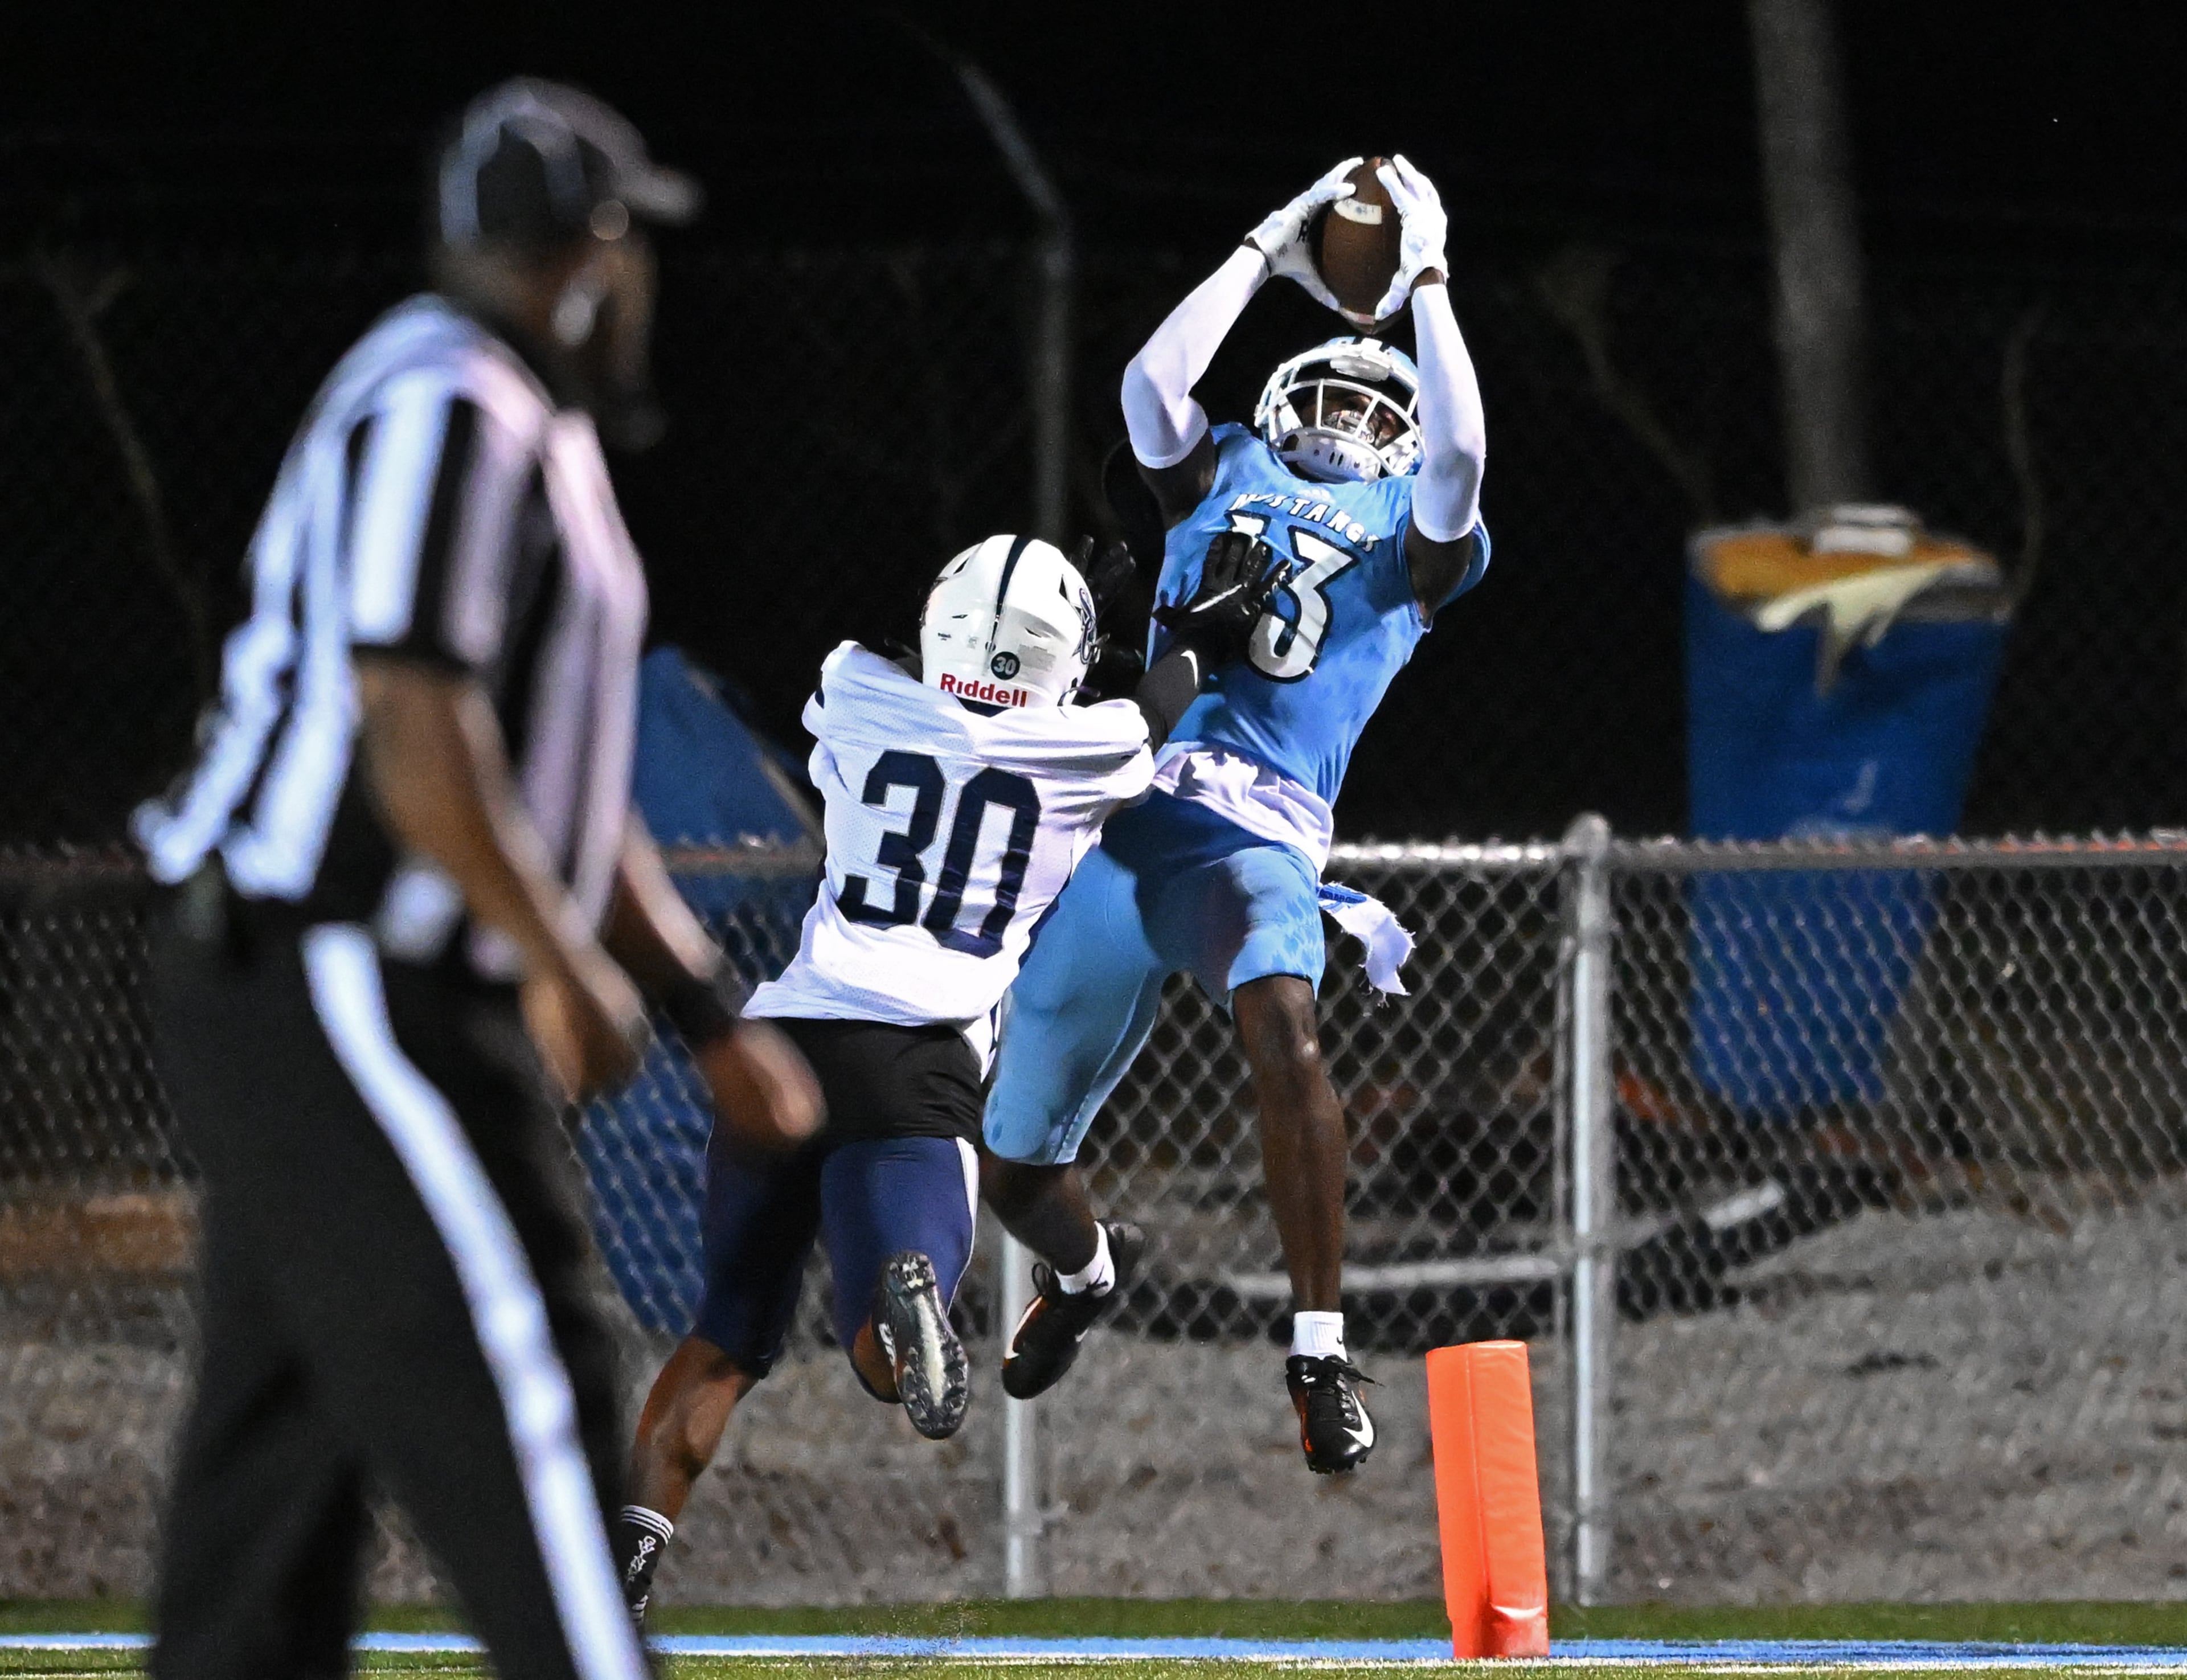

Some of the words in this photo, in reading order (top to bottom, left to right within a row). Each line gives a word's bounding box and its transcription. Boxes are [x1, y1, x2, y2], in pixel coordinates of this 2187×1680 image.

[993, 656, 1017, 675] 30
[940, 673, 1027, 707] Riddell
[837, 749, 1042, 960] 30
